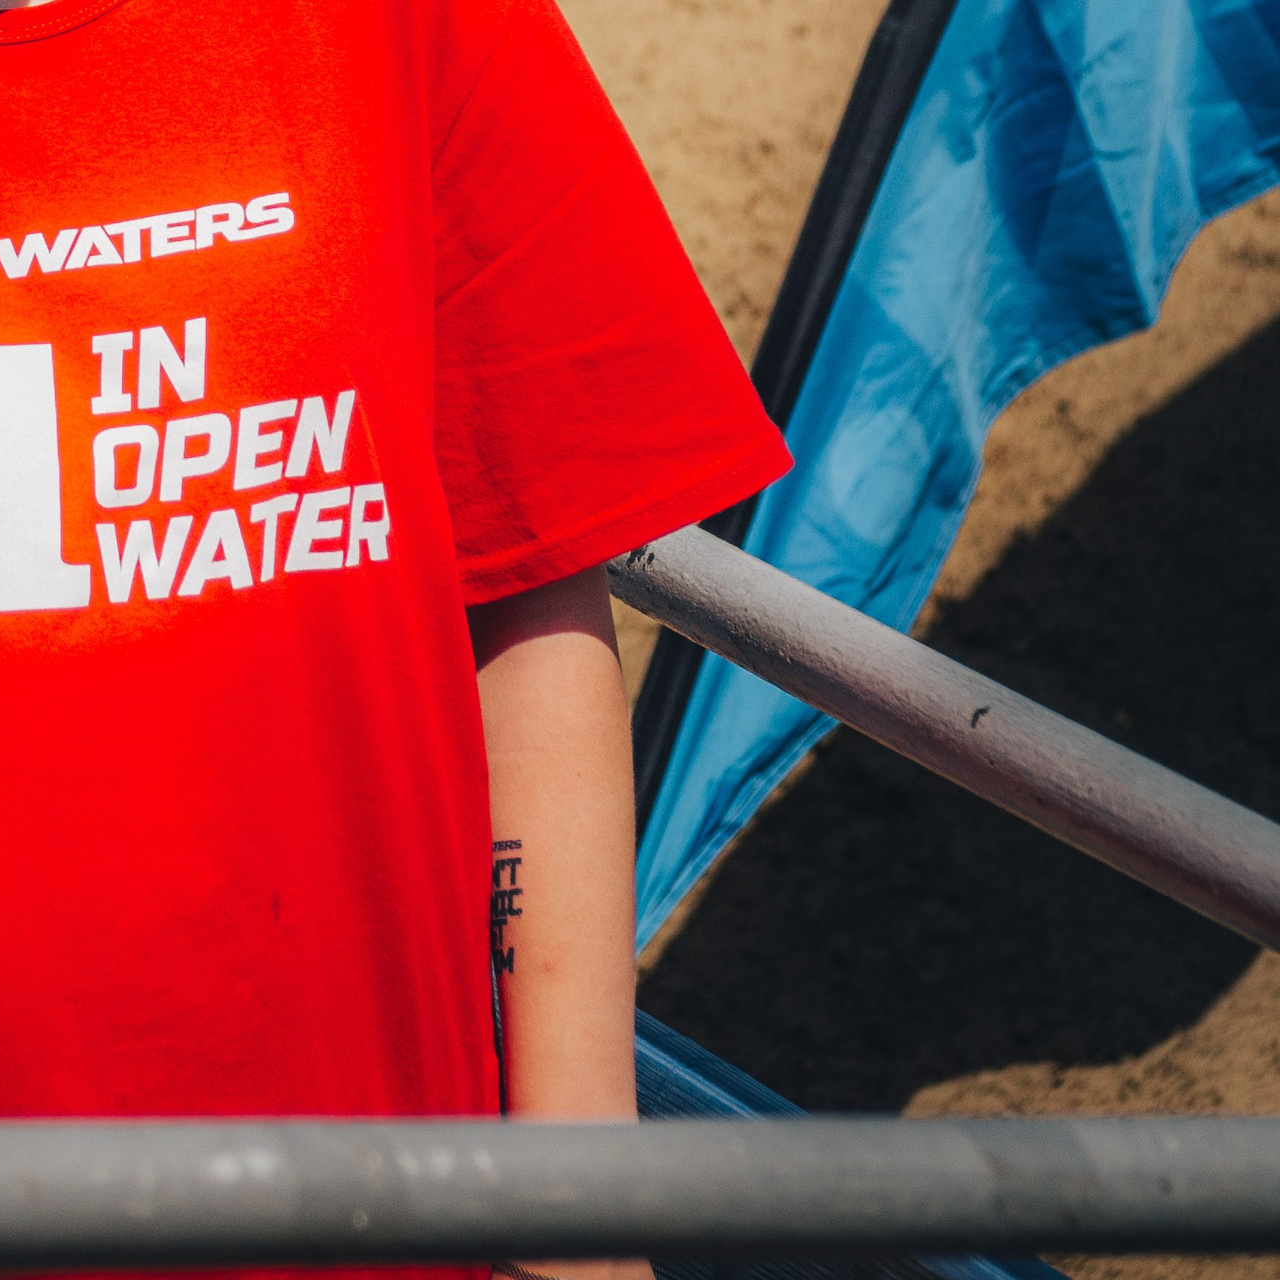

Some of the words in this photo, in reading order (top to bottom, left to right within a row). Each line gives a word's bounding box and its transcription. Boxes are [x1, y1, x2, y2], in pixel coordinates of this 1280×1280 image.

[91, 316, 207, 415] IN
[91, 389, 356, 509] OPEN
[94, 482, 391, 604] WATER
